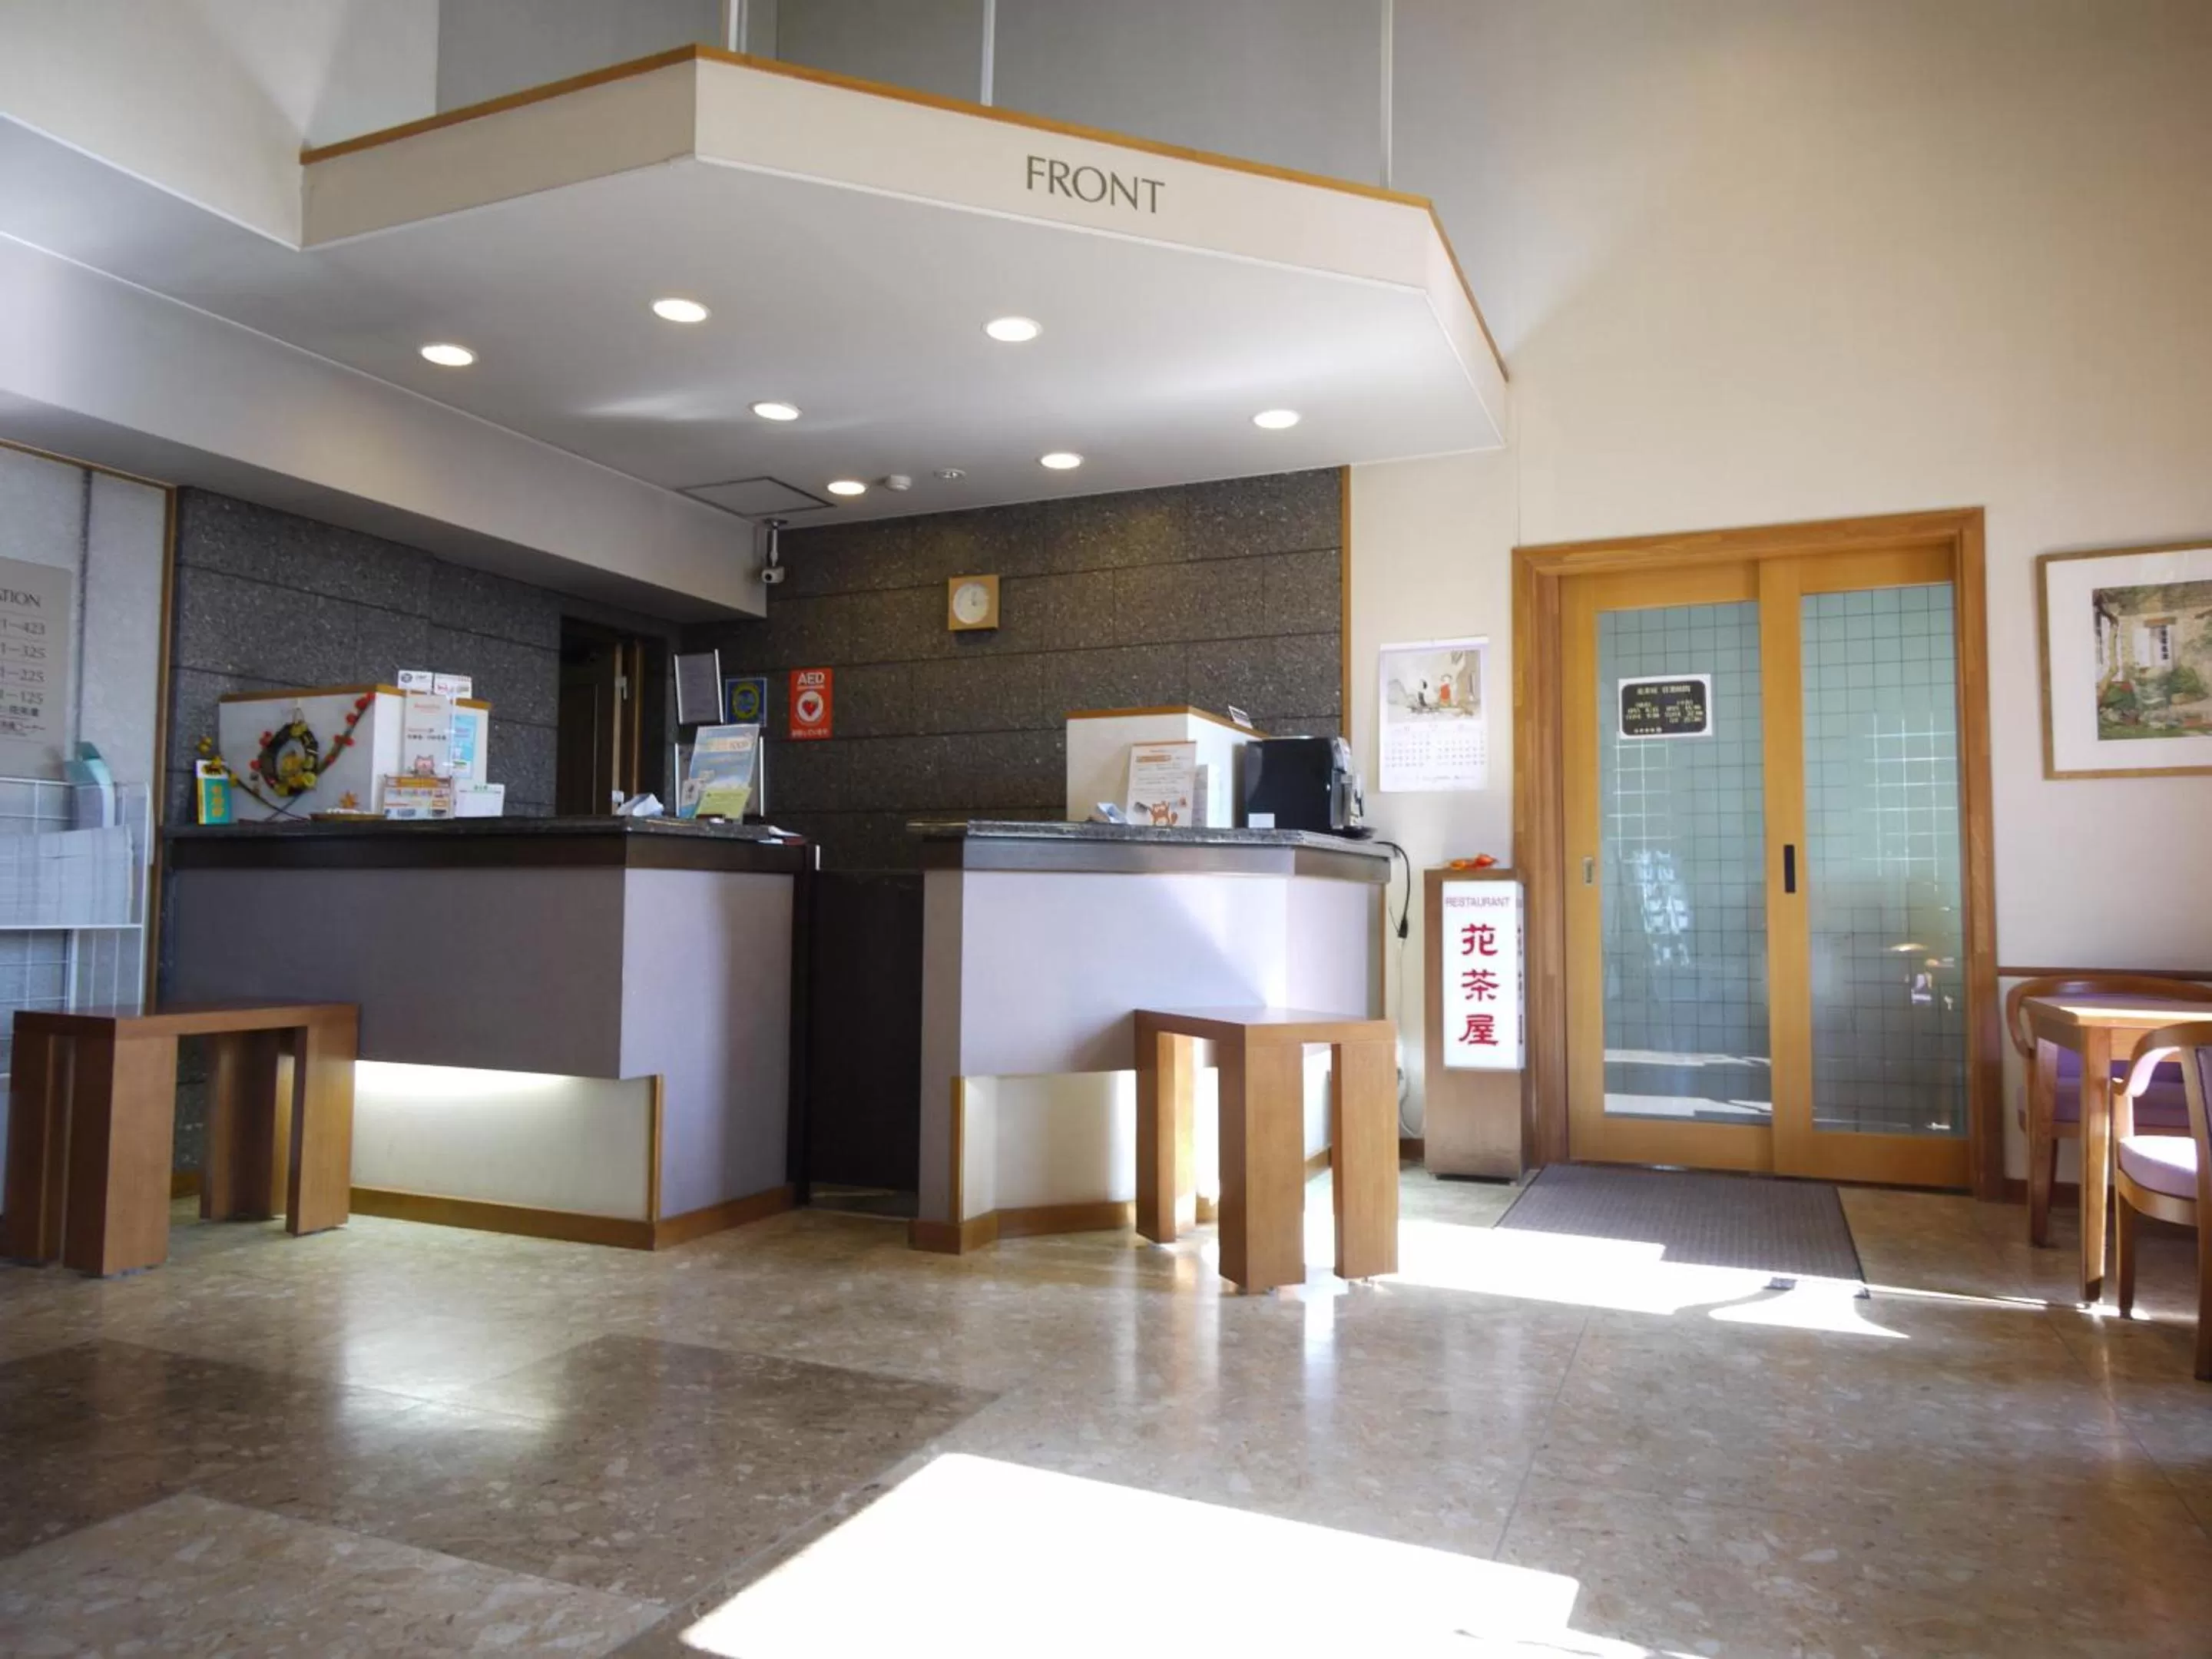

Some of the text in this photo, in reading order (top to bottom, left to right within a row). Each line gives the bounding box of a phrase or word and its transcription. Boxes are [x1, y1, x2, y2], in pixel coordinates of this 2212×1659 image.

[1027, 154, 1165, 213] FRONT
[797, 672, 825, 685] AED
[1445, 896, 1510, 908] RESTAURANT
[1459, 923, 1500, 1046] 花茶屋
